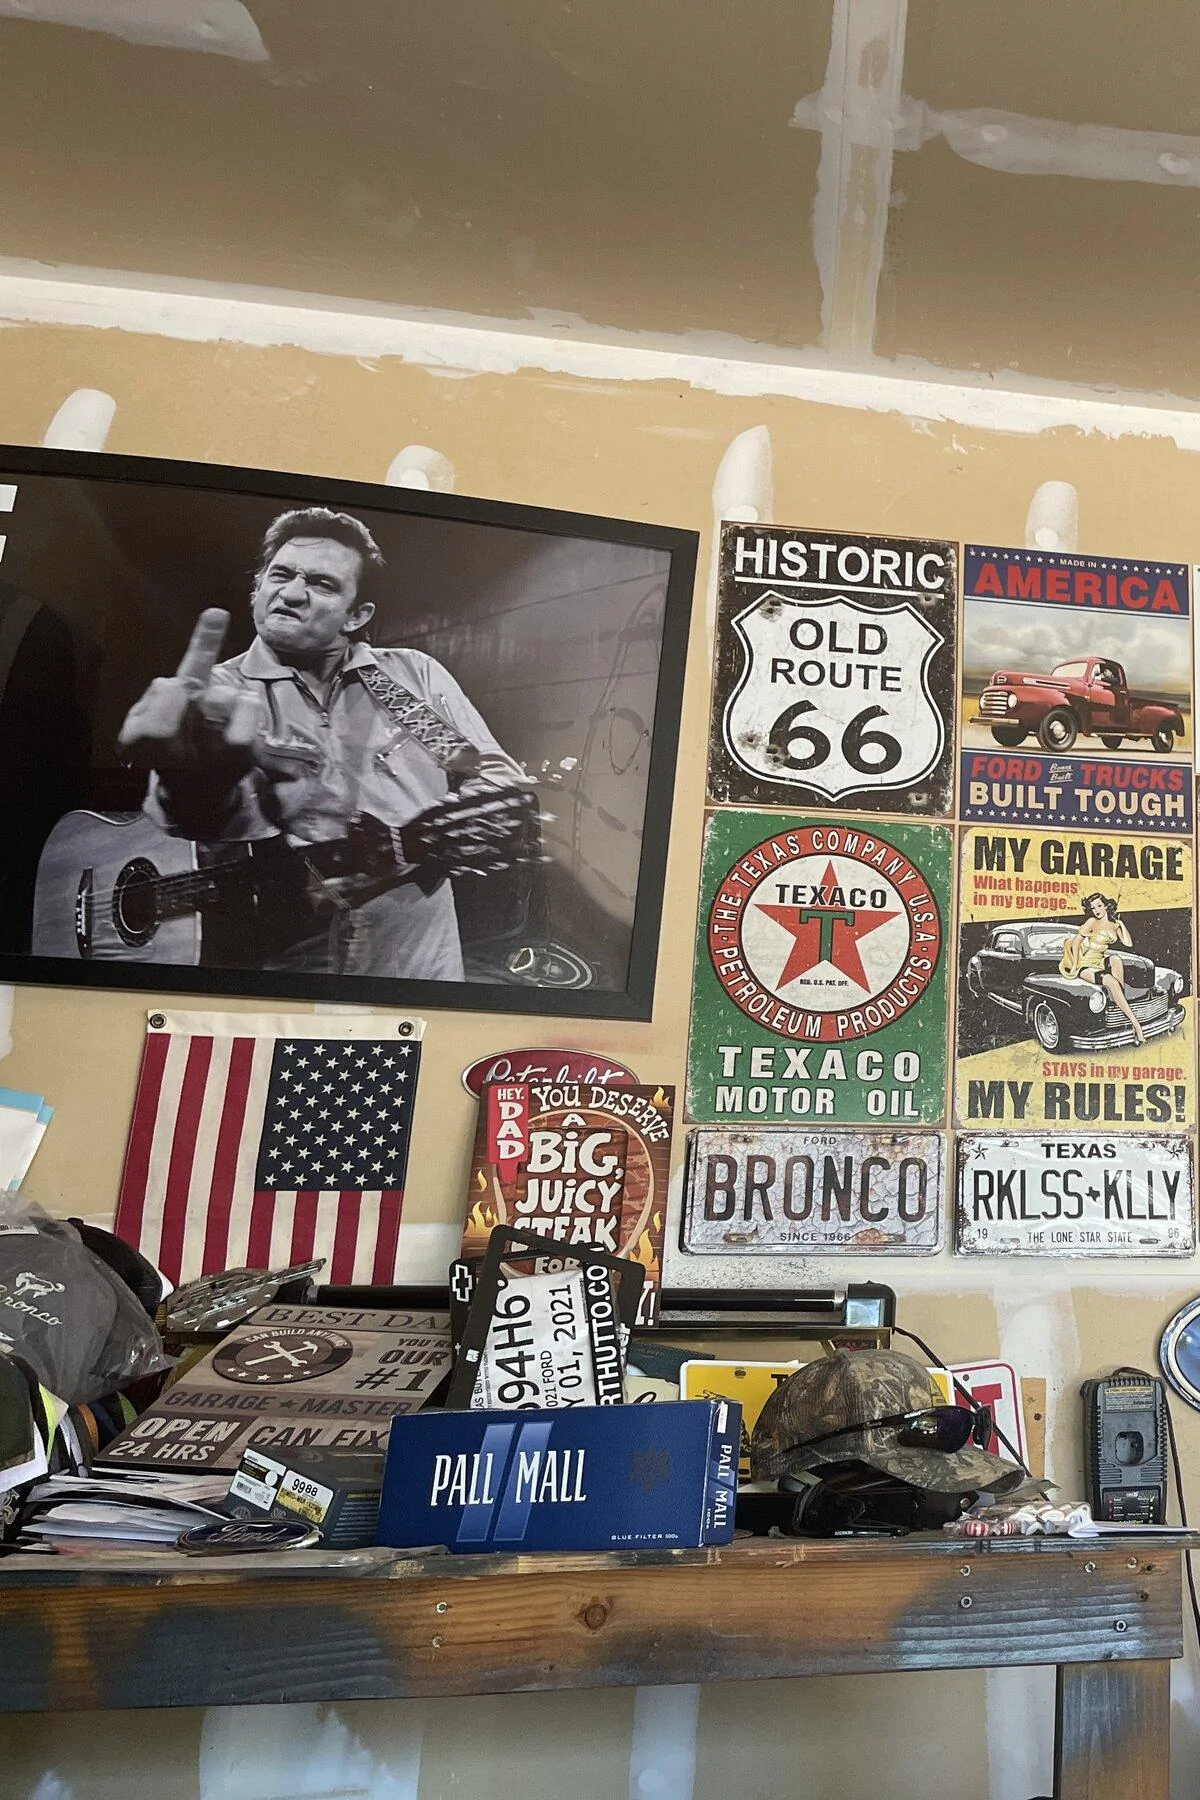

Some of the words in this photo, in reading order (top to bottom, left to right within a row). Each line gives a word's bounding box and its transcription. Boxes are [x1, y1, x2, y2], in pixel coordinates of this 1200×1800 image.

[735, 537, 945, 589] HISTORIC
[1060, 558, 1085, 567] MADE
[1088, 560, 1097, 568] IN
[973, 563, 1180, 612] AMERICA
[789, 618, 888, 655] OLD
[770, 657, 902, 692] ROUTE
[768, 700, 902, 774] 66
[971, 756, 1042, 782] FORD
[1080, 763, 1183, 791] TRUCKS
[969, 781, 1062, 810] BUILT
[1075, 788, 1185, 817] TOUGH
[974, 835, 1031, 872] MY
[1040, 839, 1184, 881] GARAGE
[713, 892, 743, 935] THE
[730, 834, 800, 888] TEXAS
[812, 829, 916, 888] COMPANY
[775, 884, 887, 909] TEXACO
[973, 875, 1012, 891] What
[1015, 878, 1079, 894] happens
[973, 892, 987, 906] in
[990, 894, 1013, 910] my
[1016, 896, 1077, 911] garage...
[715, 946, 822, 1038] PETROLEUM
[838, 955, 931, 1037] PRODUCTS
[717, 1045, 920, 1083] TEXACO
[1042, 1062, 1087, 1078] STAYS
[1090, 1063, 1104, 1077] in
[1107, 1064, 1129, 1080] my
[1132, 1065, 1187, 1081] garage.
[531, 1085, 581, 1112] YOU
[589, 1086, 670, 1143] DESERVE
[715, 1086, 835, 1115] MOTOR
[866, 1090, 920, 1117] OIL
[968, 1079, 1033, 1120] MY
[1044, 1082, 1186, 1122] RULES!
[496, 1102, 525, 1160] DAD
[561, 1113, 587, 1127] A
[803, 1136, 837, 1145] FORD
[1041, 1143, 1117, 1159] TEXAS
[703, 1154, 928, 1223] BRONCO
[973, 1169, 1083, 1221] RKLSS
[1104, 1170, 1181, 1221] KLLY
[780, 1232, 818, 1242] SINCE
[823, 1233, 851, 1242] 1966
[977, 1228, 988, 1239] 19
[1027, 1231, 1044, 1243] THE
[1051, 1231, 1072, 1243] LONE
[1079, 1232, 1101, 1243] STAR
[1107, 1232, 1132, 1243] STATE
[1168, 1228, 1179, 1239] 96
[265, 1308, 376, 1326] BEST
[379, 1314, 451, 1330] DA
[548, 1284, 577, 1342] 2021
[244, 1333, 269, 1343] CAN
[271, 1328, 306, 1337] BUILD
[492, 1294, 541, 1410] 94H6
[378, 1349, 450, 1366] OUR
[539, 1350, 554, 1383] FORD
[556, 1351, 584, 1389] 01,
[354, 1367, 432, 1392] #1
[164, 1391, 271, 1411] GARAGE
[299, 1397, 414, 1417] MASTER
[132, 1416, 241, 1443] OPEN
[248, 1425, 323, 1447] CAN
[332, 1428, 390, 1449] FIX
[108, 1440, 148, 1458] 24
[152, 1442, 217, 1462] HRS
[717, 1444, 733, 1479] PALL
[291, 1478, 318, 1497] 9988
[430, 1451, 495, 1507] PALL
[515, 1449, 587, 1504] MALL
[713, 1490, 728, 1529] MALL
[207, 1524, 288, 1542] Ford
